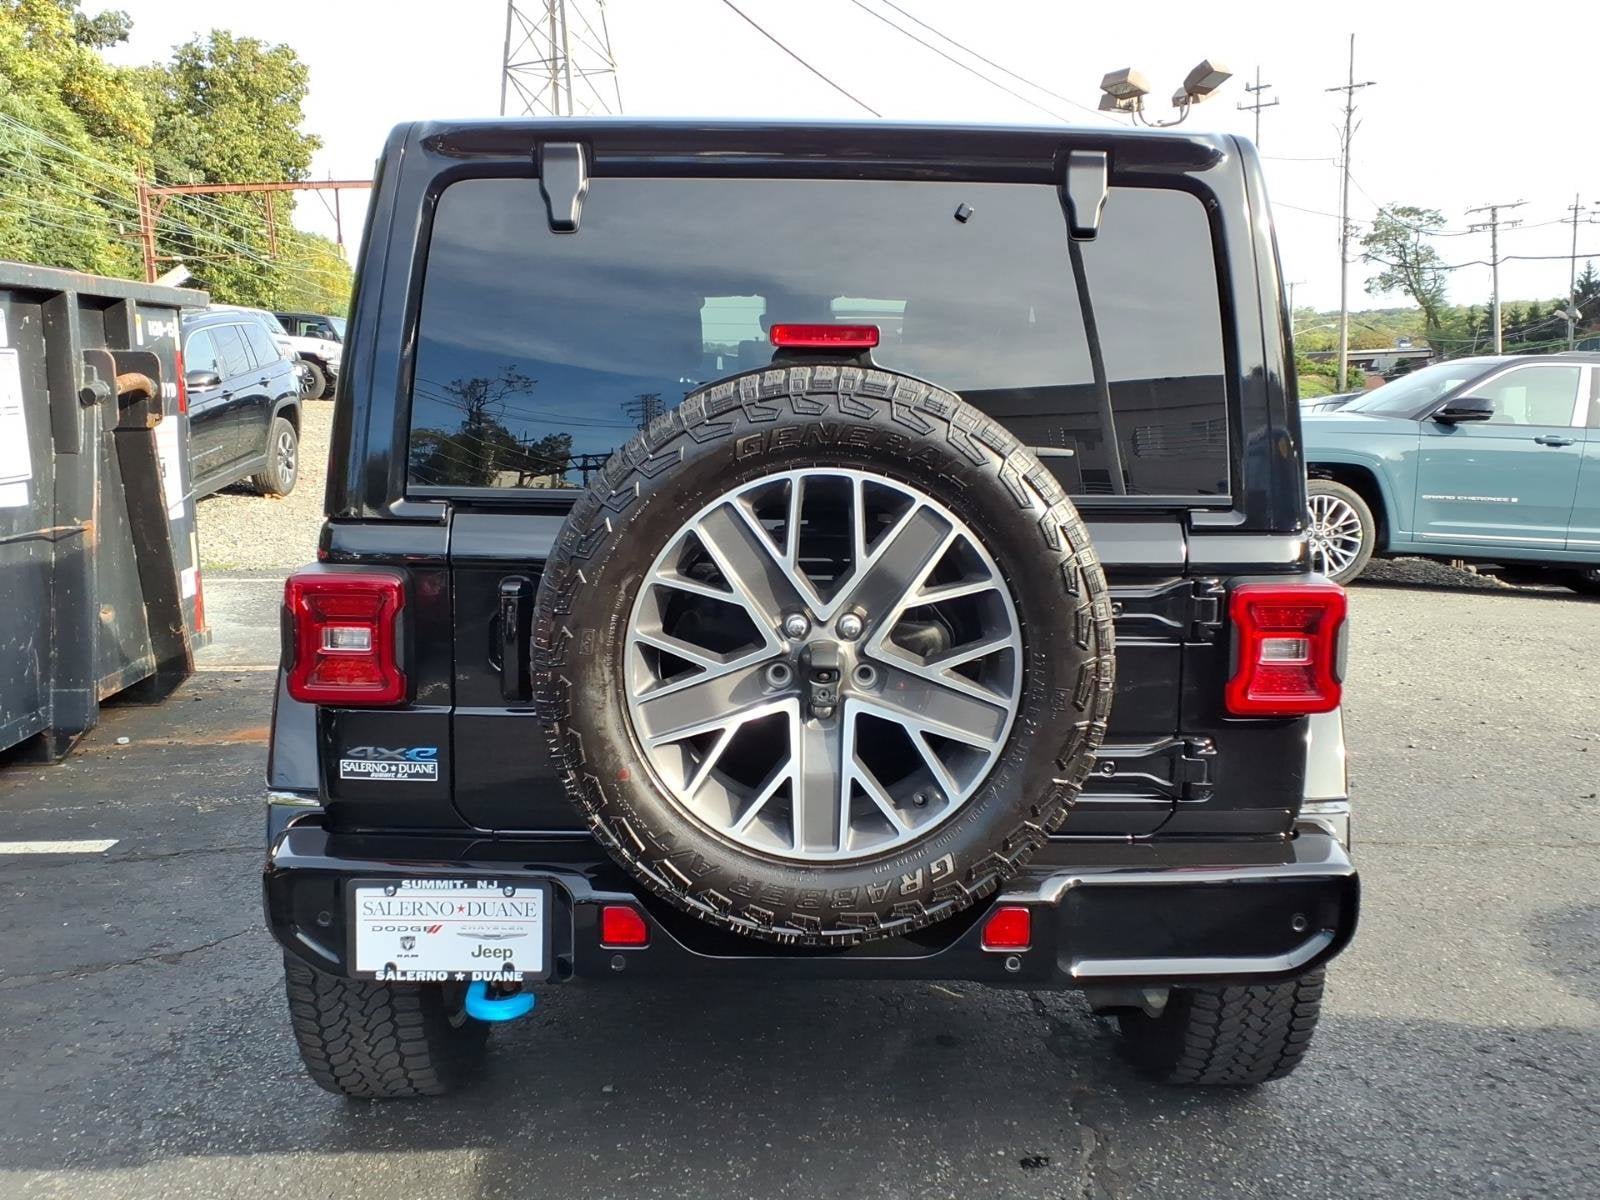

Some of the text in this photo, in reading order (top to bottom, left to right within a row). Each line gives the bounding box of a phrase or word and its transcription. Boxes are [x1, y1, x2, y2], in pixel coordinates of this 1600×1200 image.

[735, 421, 969, 490] GENERAL
[343, 762, 435, 774] SALERNO DUANE
[476, 880, 498, 889] NJ
[727, 851, 956, 908] GRABBER
[362, 900, 537, 918] SALERNO DUANE
[371, 925, 430, 933] DODGE
[471, 944, 513, 960] Jeep
[375, 970, 524, 982] SALERNO DUANE
